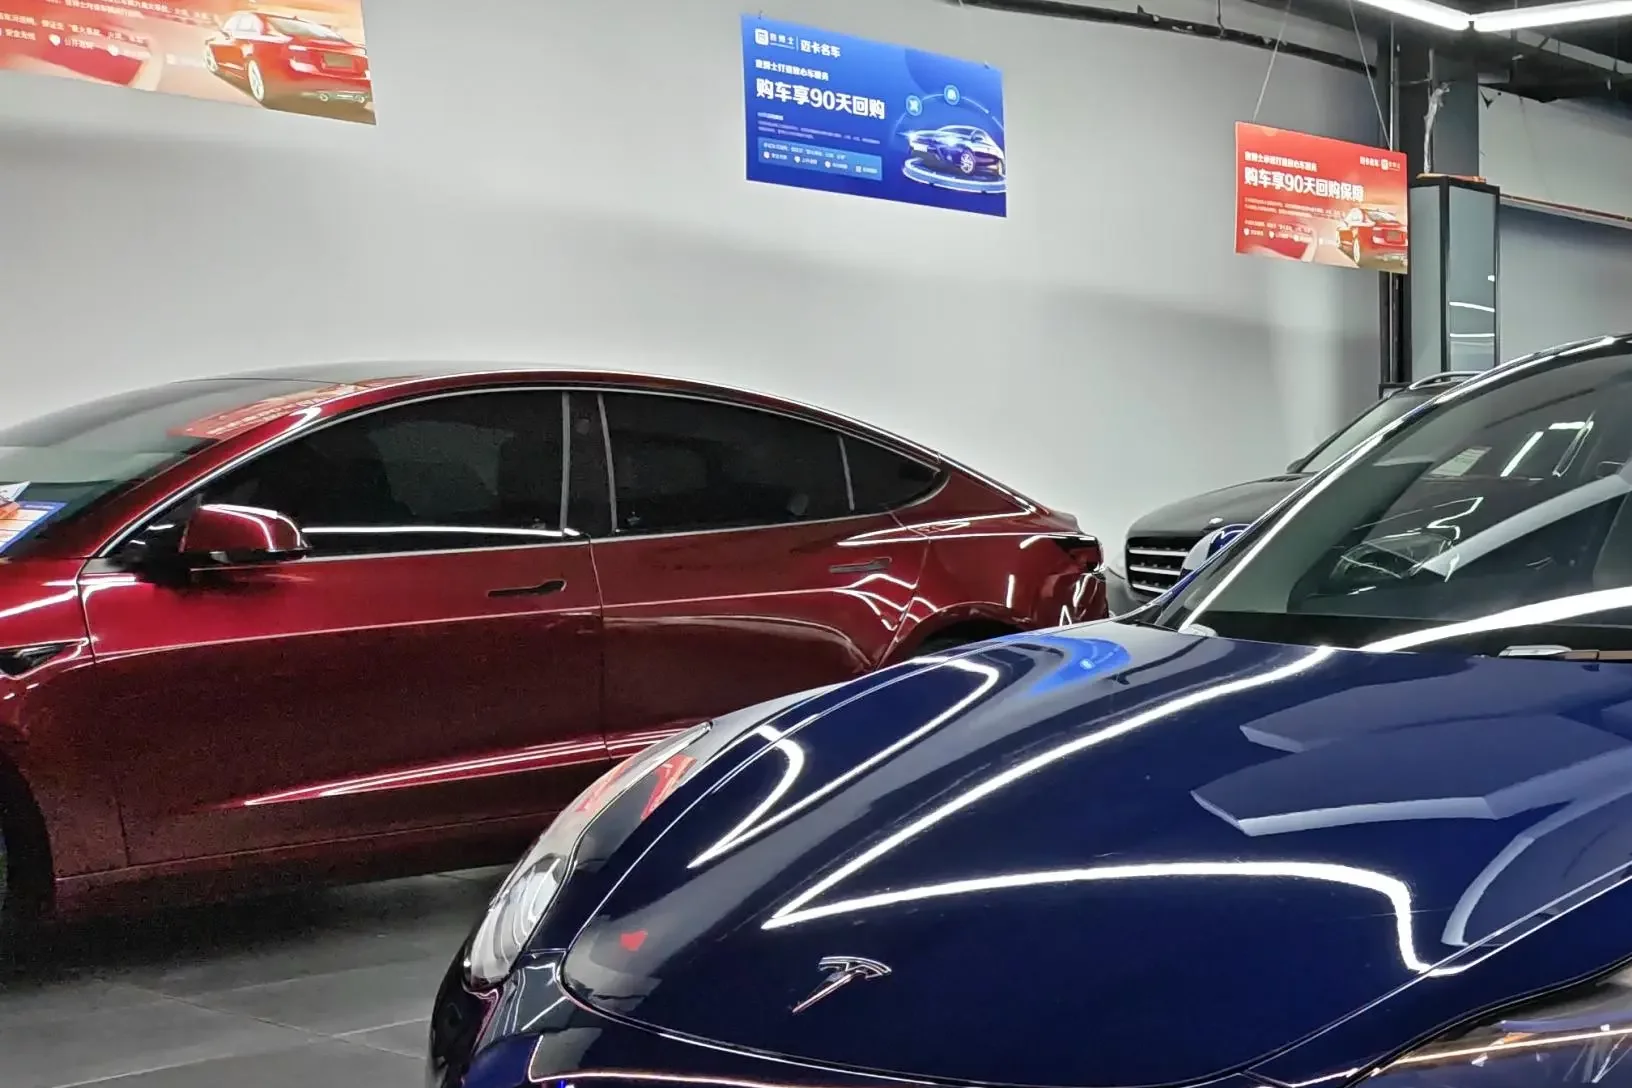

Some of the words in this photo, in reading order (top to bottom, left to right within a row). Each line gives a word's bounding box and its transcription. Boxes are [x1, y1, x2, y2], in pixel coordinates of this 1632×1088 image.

[756, 78, 885, 119] 购车享90天回购
[1244, 167, 1364, 202] 购车享90天回购保障
